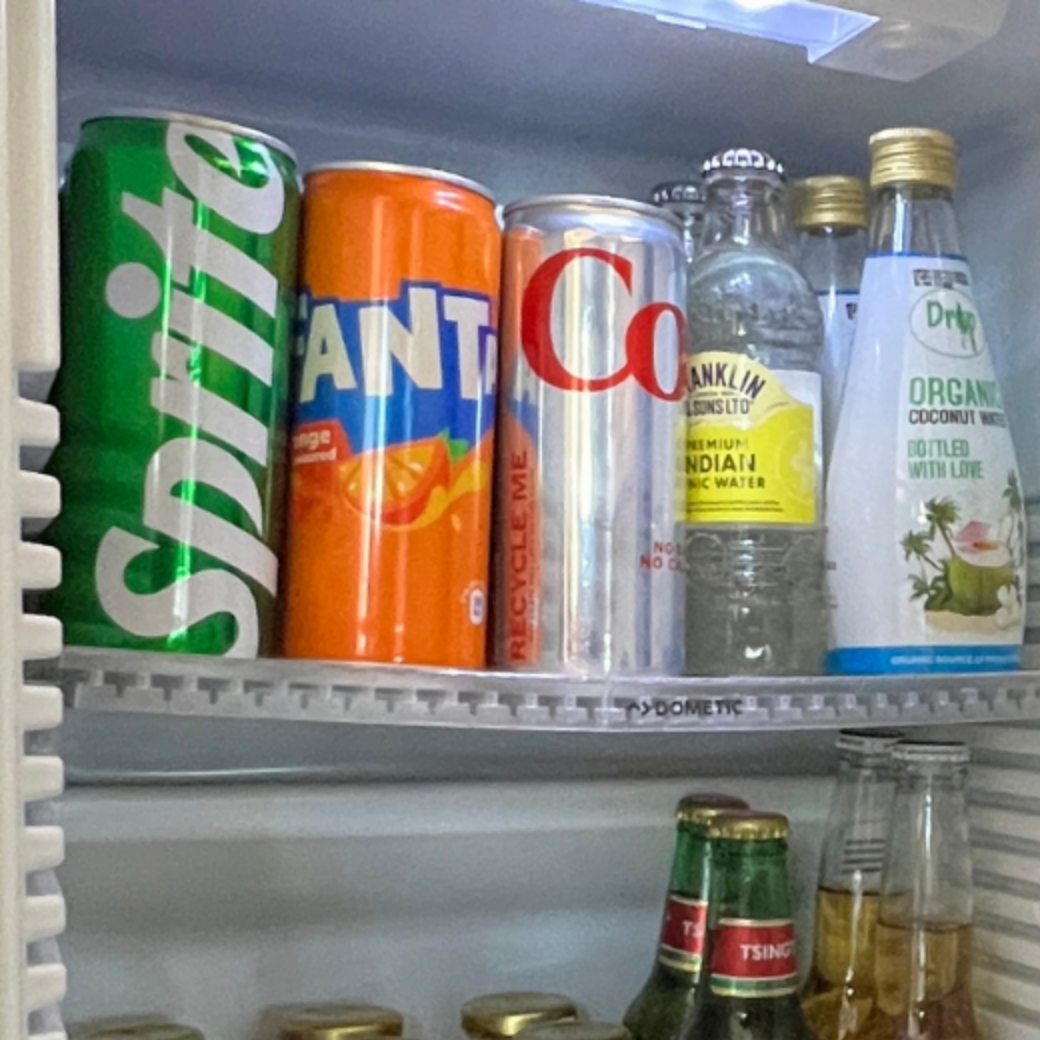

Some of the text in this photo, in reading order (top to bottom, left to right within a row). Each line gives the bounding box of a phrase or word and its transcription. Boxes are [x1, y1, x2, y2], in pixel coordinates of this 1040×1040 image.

[96, 121, 285, 659] Sprite
[686, 453, 756, 474] NDIAN
[715, 477, 766, 489] WATER
[509, 513, 528, 661] RECYCLE
[655, 700, 744, 717] DOMETIC
